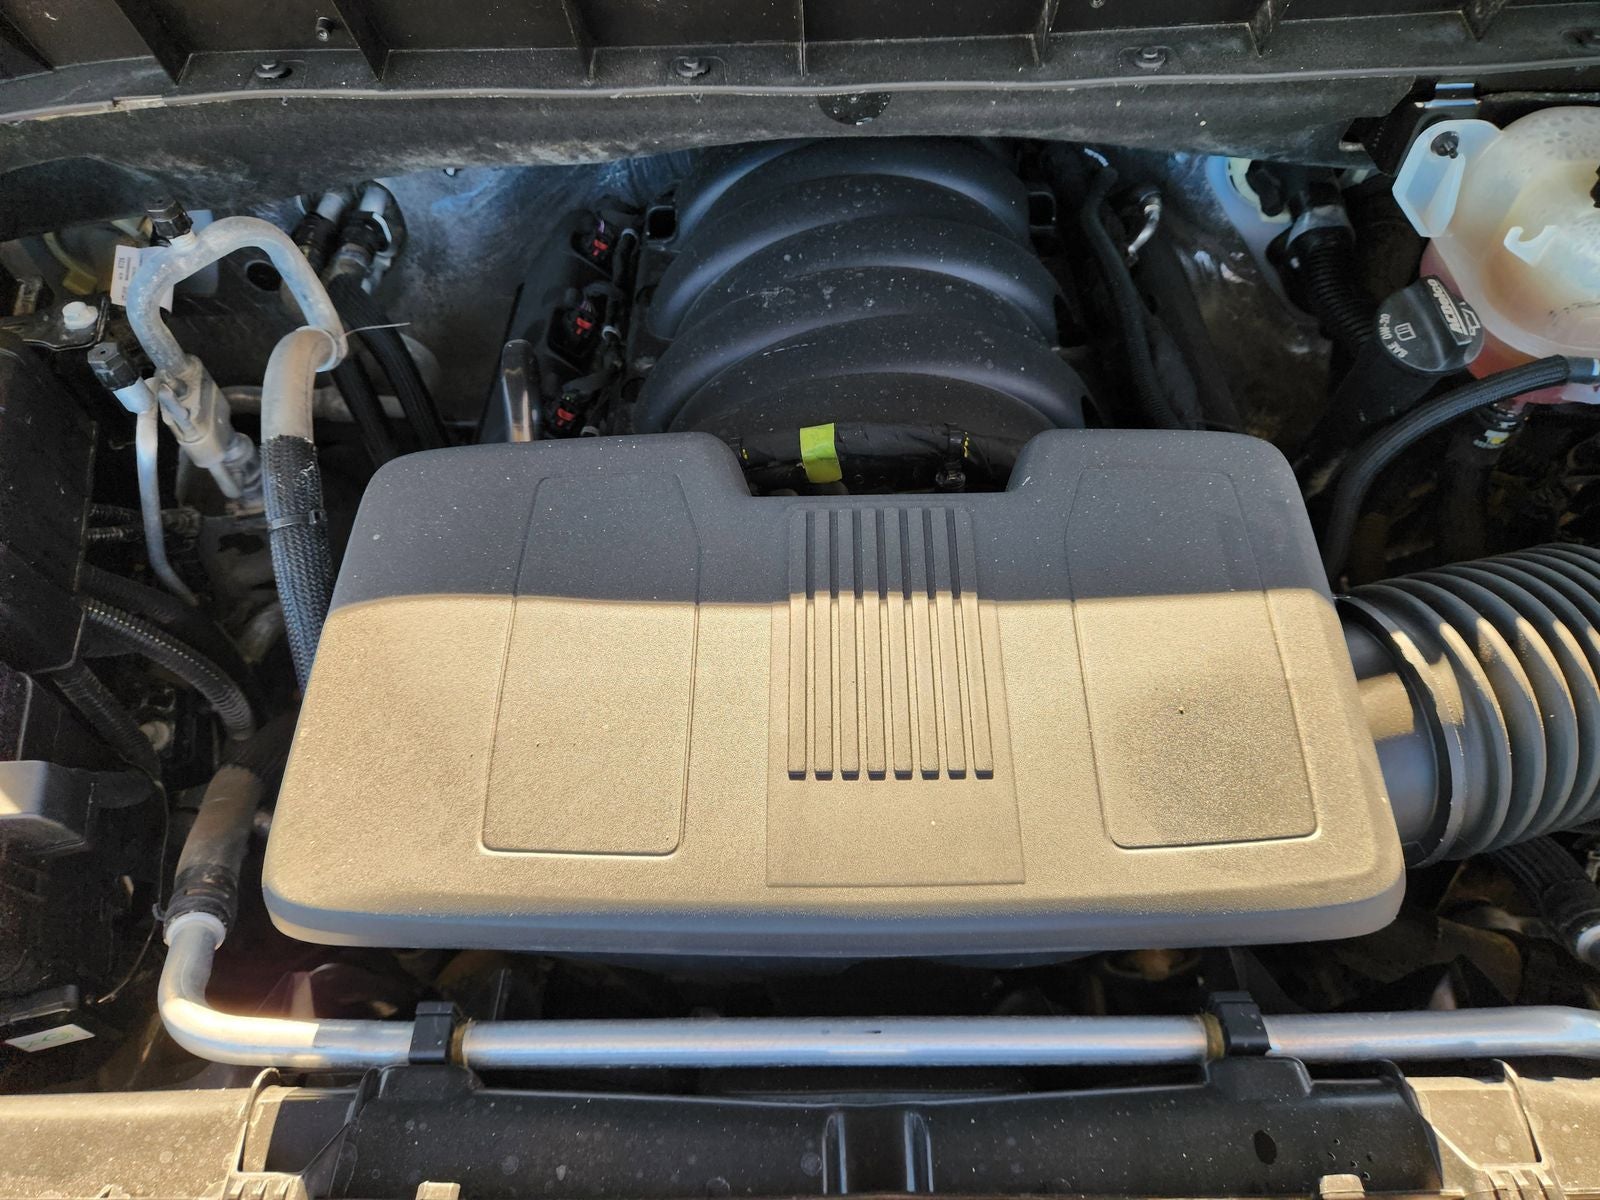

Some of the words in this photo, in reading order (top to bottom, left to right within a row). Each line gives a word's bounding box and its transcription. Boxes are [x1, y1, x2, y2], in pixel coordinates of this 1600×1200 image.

[1427, 278, 1466, 335] ACDelco
[1379, 313, 1393, 340] 0W-20
[1386, 341, 1408, 358] SAE
